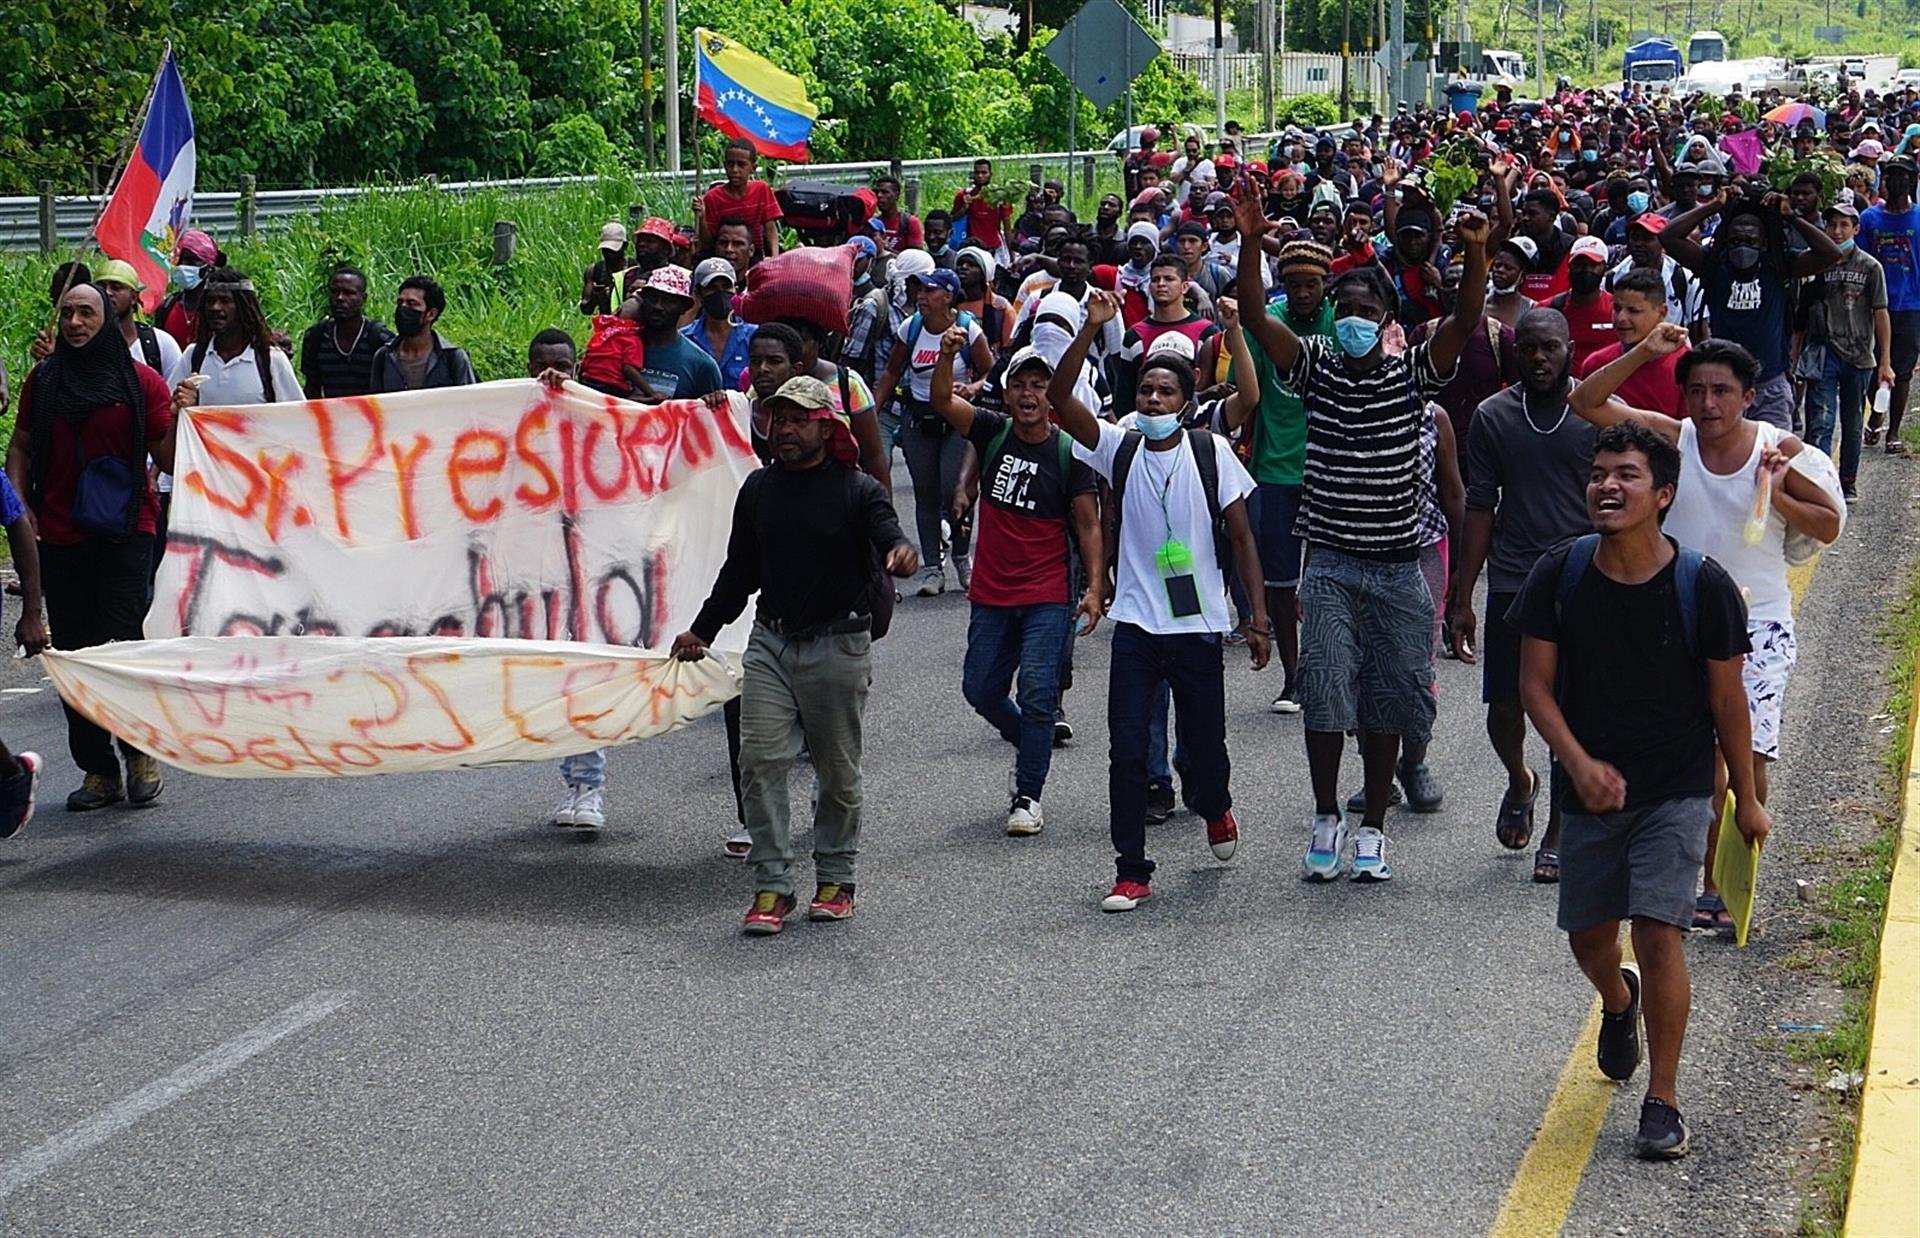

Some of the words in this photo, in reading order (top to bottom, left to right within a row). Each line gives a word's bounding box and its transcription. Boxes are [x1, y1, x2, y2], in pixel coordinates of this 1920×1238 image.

[1727, 300, 1761, 310] WHEN?
[913, 349, 941, 364] NIK
[999, 454, 1014, 473] DO
[991, 471, 1009, 501] JUST
